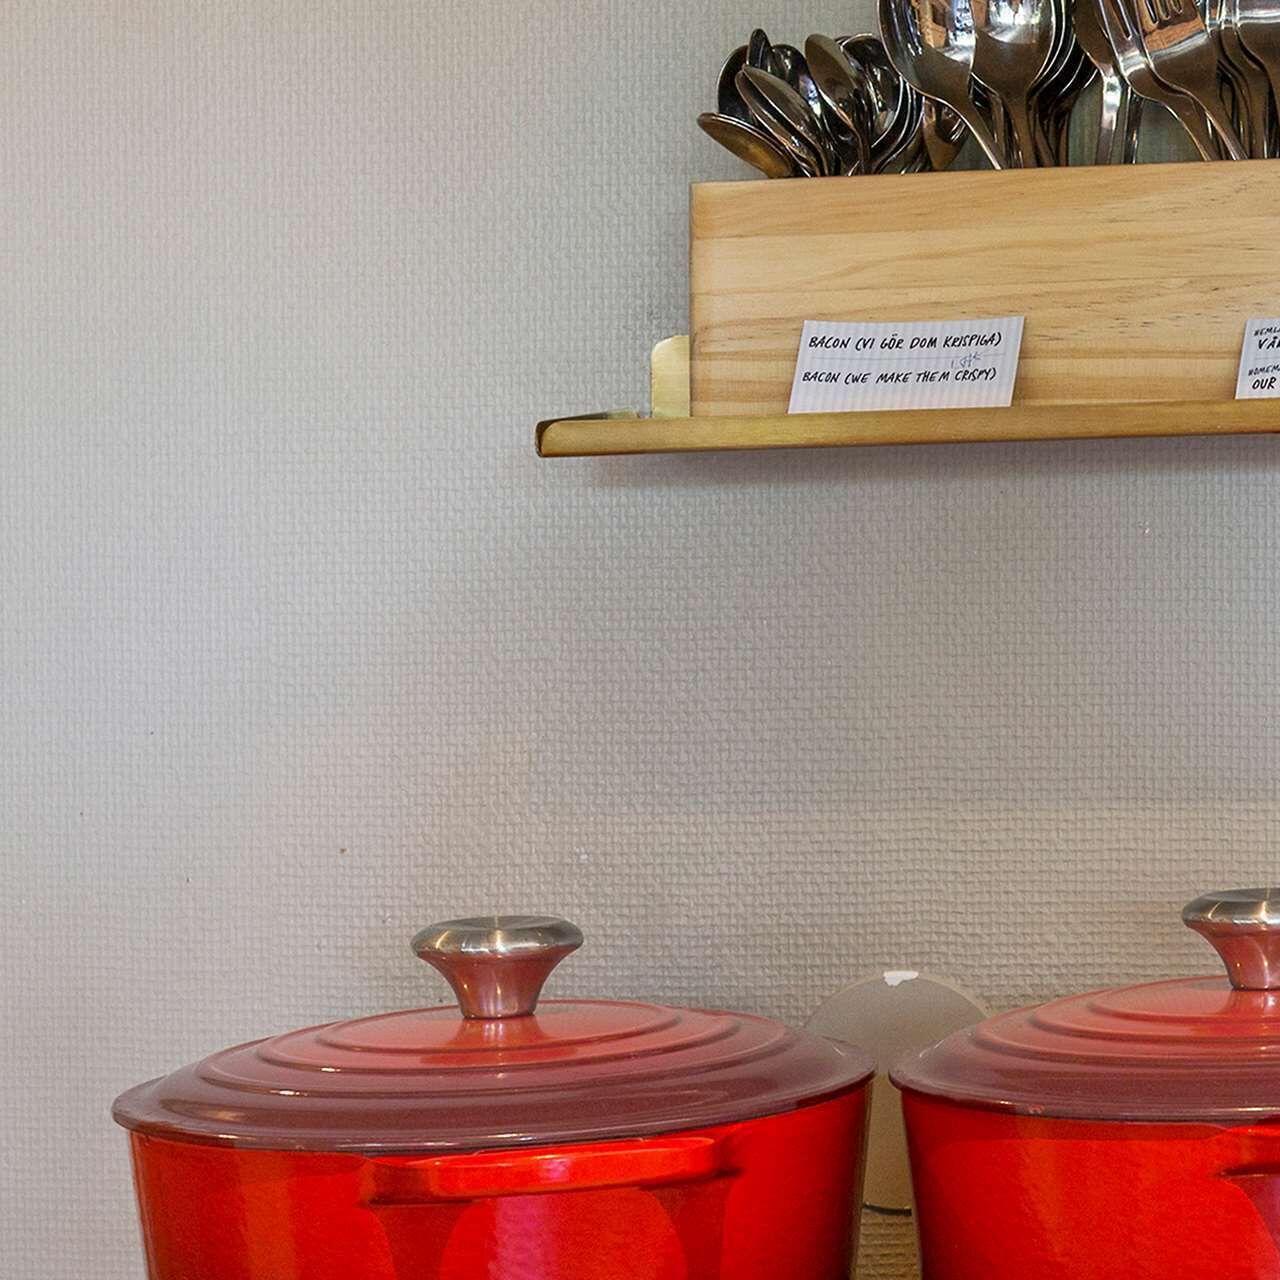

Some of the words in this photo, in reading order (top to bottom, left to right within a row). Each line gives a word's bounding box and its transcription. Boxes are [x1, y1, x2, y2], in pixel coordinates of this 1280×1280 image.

[808, 335, 851, 349] BACON
[855, 336, 874, 351] (VI
[880, 333, 903, 349] GÖR
[909, 334, 937, 349] DOM
[942, 331, 1002, 348] KRISPIGA)
[802, 370, 840, 384] BACON
[844, 371, 871, 385] (WE
[876, 371, 910, 384] MAKE
[915, 369, 950, 383] THEM
[954, 367, 997, 382] CRISPY)
[1251, 377, 1276, 390] OUR
